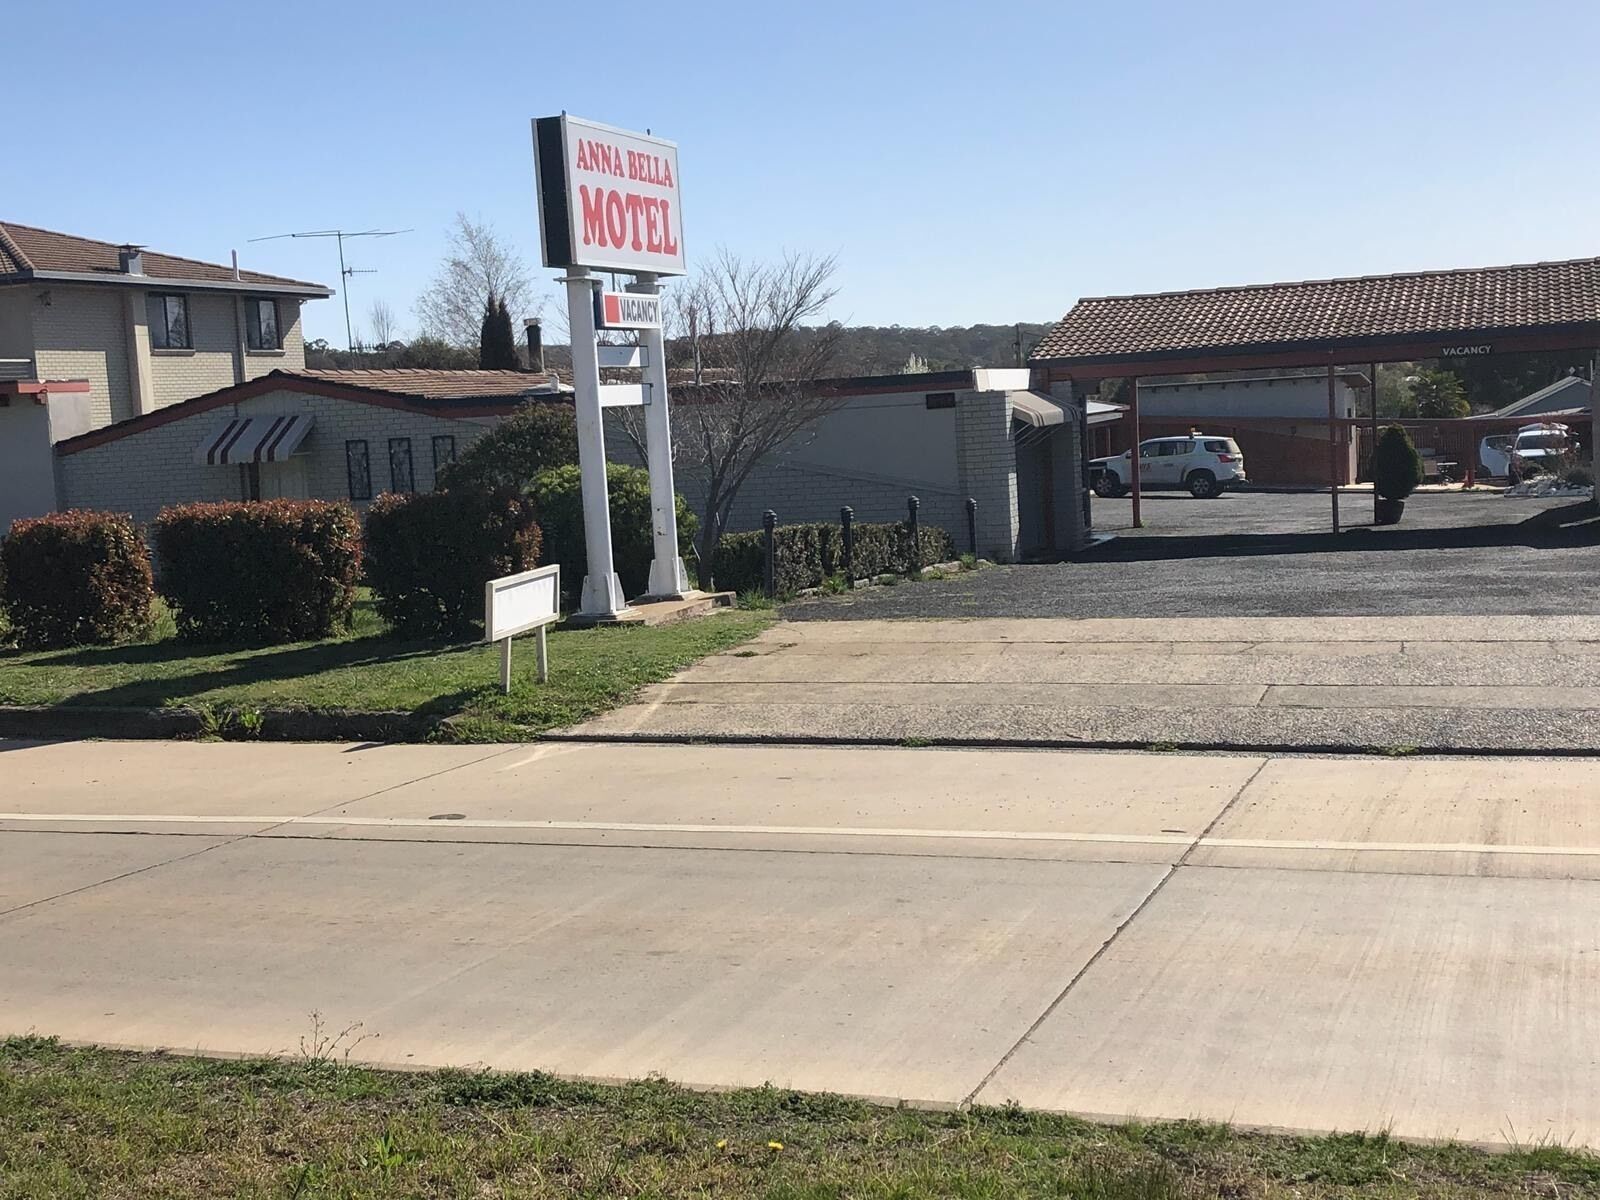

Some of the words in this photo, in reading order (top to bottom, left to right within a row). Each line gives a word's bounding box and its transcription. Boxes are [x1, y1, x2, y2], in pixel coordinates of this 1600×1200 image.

[577, 138, 625, 178] ANNA
[627, 150, 673, 188] BELLA
[579, 184, 677, 256] MOTEL
[620, 299, 658, 322] VACANCY
[1442, 345, 1491, 356] VACANCY
